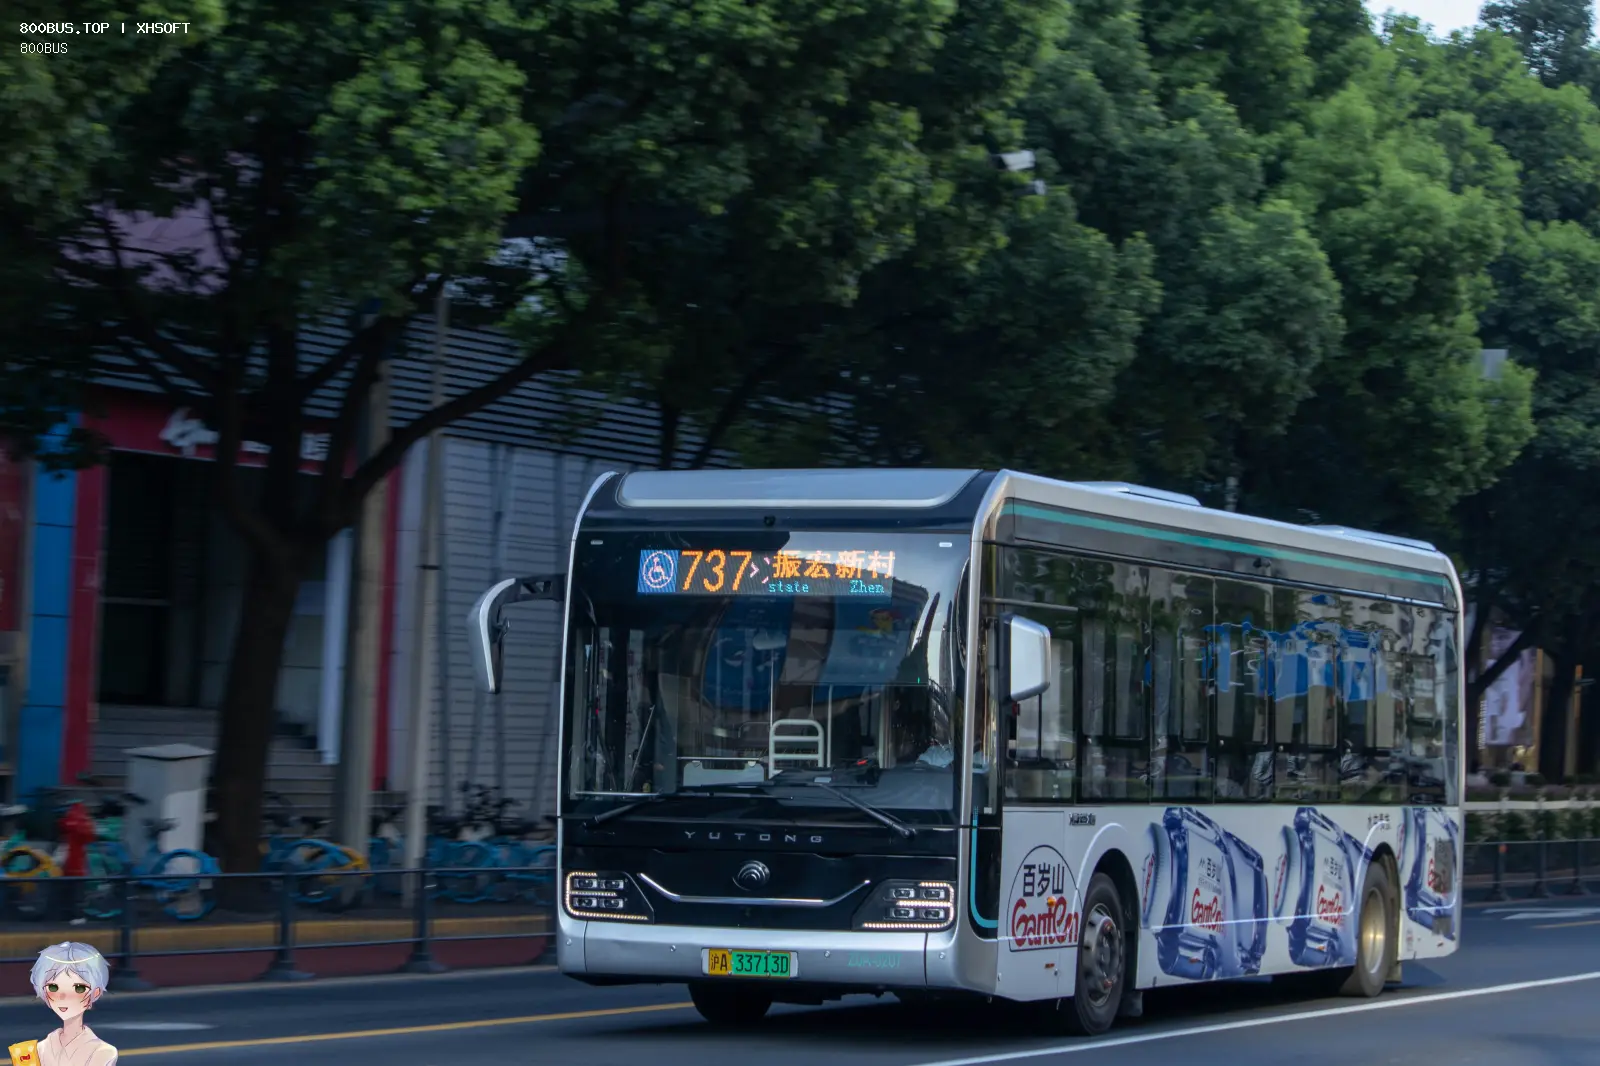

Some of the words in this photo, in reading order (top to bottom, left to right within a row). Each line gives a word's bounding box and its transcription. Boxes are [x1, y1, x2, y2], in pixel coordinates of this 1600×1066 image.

[681, 549, 753, 593] 737
[772, 549, 896, 579] 振宏新村
[768, 581, 809, 593] state
[849, 580, 885, 593] Zhen
[684, 830, 823, 843] YUTONG
[1022, 862, 1065, 898] 百岁山
[735, 953, 789, 975] 33713D
